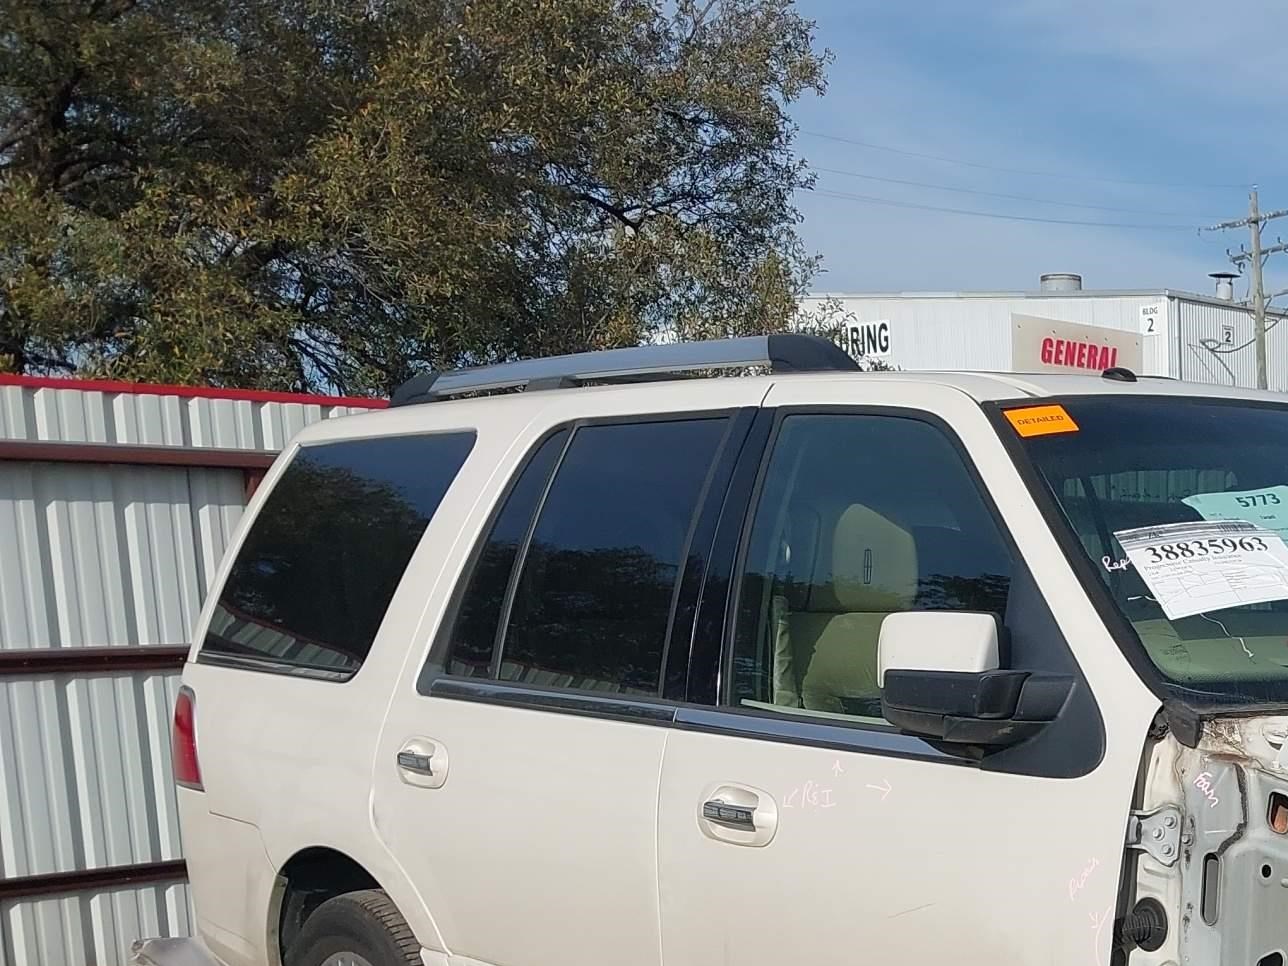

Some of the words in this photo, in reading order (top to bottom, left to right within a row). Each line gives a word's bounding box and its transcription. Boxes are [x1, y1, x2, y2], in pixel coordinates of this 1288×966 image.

[1142, 306, 1158, 315] BLDG
[1147, 318, 1155, 333] 2
[1224, 331, 1232, 342] 2
[1041, 337, 1118, 370] GENERAL
[1017, 415, 1065, 426] DETAILED
[1236, 493, 1281, 508] 5773
[1145, 536, 1268, 564] 38835963
